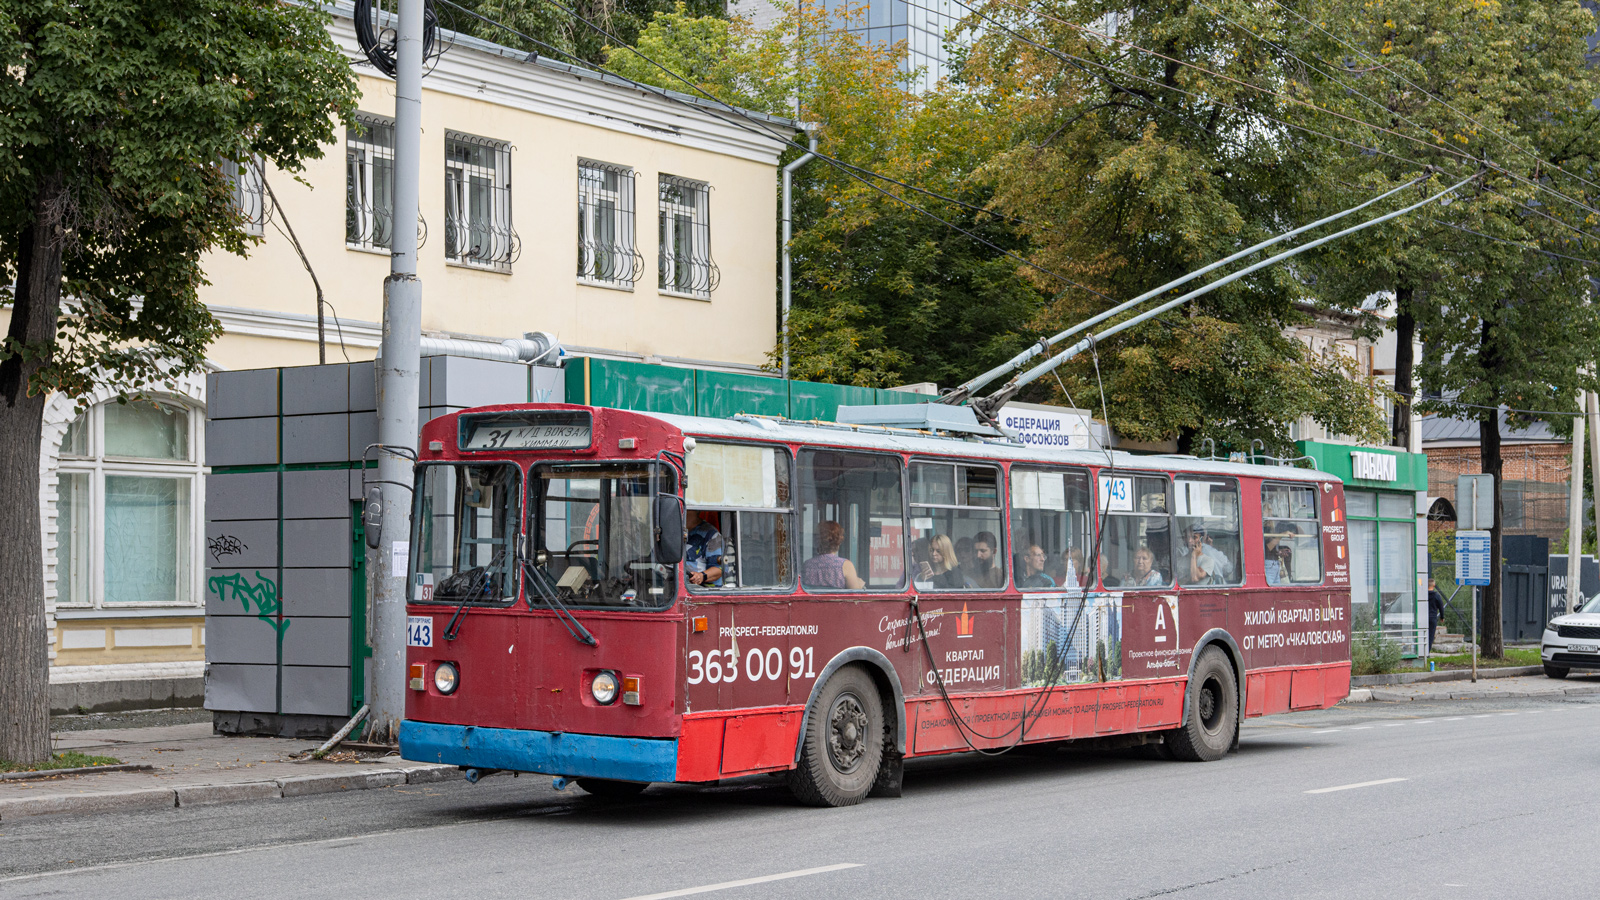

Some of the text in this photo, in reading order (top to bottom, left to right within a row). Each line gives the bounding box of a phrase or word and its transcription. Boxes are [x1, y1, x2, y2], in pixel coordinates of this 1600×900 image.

[1005, 416, 1060, 432] ФЕДЕРАЦИЯ
[483, 429, 513, 448] 31
[515, 426, 590, 438] Ж/Д ВОКЗАЛ
[1007, 433, 1069, 446] ОФСОЮЗОВ
[1350, 451, 1397, 482] ТАБАКИ
[1105, 479, 1126, 500] 143
[1322, 525, 1344, 533] PROSPECT
[1330, 534, 1345, 542] GROUP
[422, 587, 432, 600] 31
[1244, 607, 1275, 626] ЖИЛОЙ
[1277, 608, 1313, 623] КВАРТАЛ
[1315, 608, 1320, 621] В
[1322, 607, 1344, 621] ШАГЕ
[407, 624, 431, 646] 143
[719, 625, 819, 637] PROSPECT-FEDERATION.RU
[1243, 630, 1346, 650] ОТ МЕТРО «ЧКАЛОВСКАЯ»
[945, 649, 984, 662] КВАРТАЛ
[1128, 650, 1154, 659] Проектное
[687, 646, 816, 685] 363 00 91
[926, 665, 1000, 686] ФЕДЕРАЦИЯ
[975, 710, 1011, 723] ПРОЕКТНОЙ
